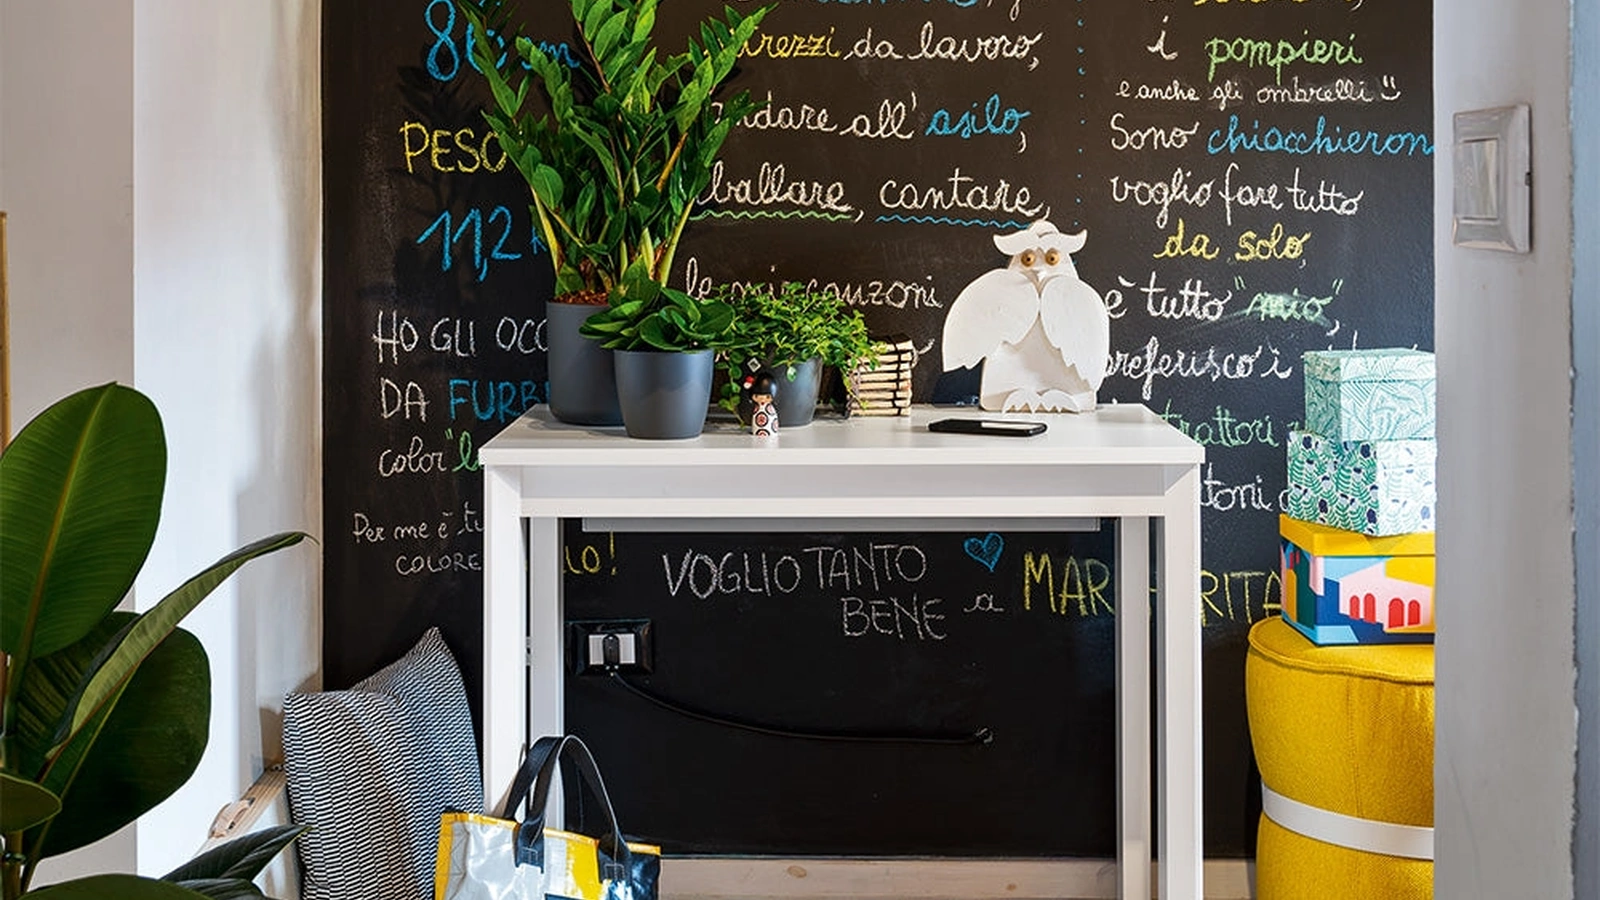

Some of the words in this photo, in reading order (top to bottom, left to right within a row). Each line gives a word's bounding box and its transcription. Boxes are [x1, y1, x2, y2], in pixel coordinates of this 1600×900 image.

[843, 27, 903, 60] da
[907, 21, 1043, 71] lavoro,
[1147, 15, 1179, 61] i
[1204, 30, 1364, 86] pompieri
[839, 90, 918, 140] all'
[1135, 80, 1201, 102] anche
[1209, 80, 1244, 111] gli
[1256, 76, 1374, 103] ombrelli
[400, 121, 507, 173] PESO
[1109, 112, 1201, 151] Sono
[1110, 167, 1216, 229] voglio
[1218, 162, 1283, 226] fare
[1285, 167, 1365, 215] tutto
[416, 205, 522, 282] 11,2
[1153, 218, 1219, 259] da
[685, 256, 712, 300] le
[1104, 275, 1127, 319] è
[1140, 271, 1233, 321] tutto
[372, 310, 420, 365] HO
[429, 316, 477, 358] GLI
[379, 376, 430, 423] DA
[378, 436, 448, 478] color
[353, 512, 385, 544] Per
[393, 520, 430, 540] me
[395, 549, 483, 577] COLORE
[661, 548, 801, 600] VOGLIO
[803, 541, 927, 592] TANTO
[841, 593, 948, 641] BENE
[962, 593, 1004, 614] a
